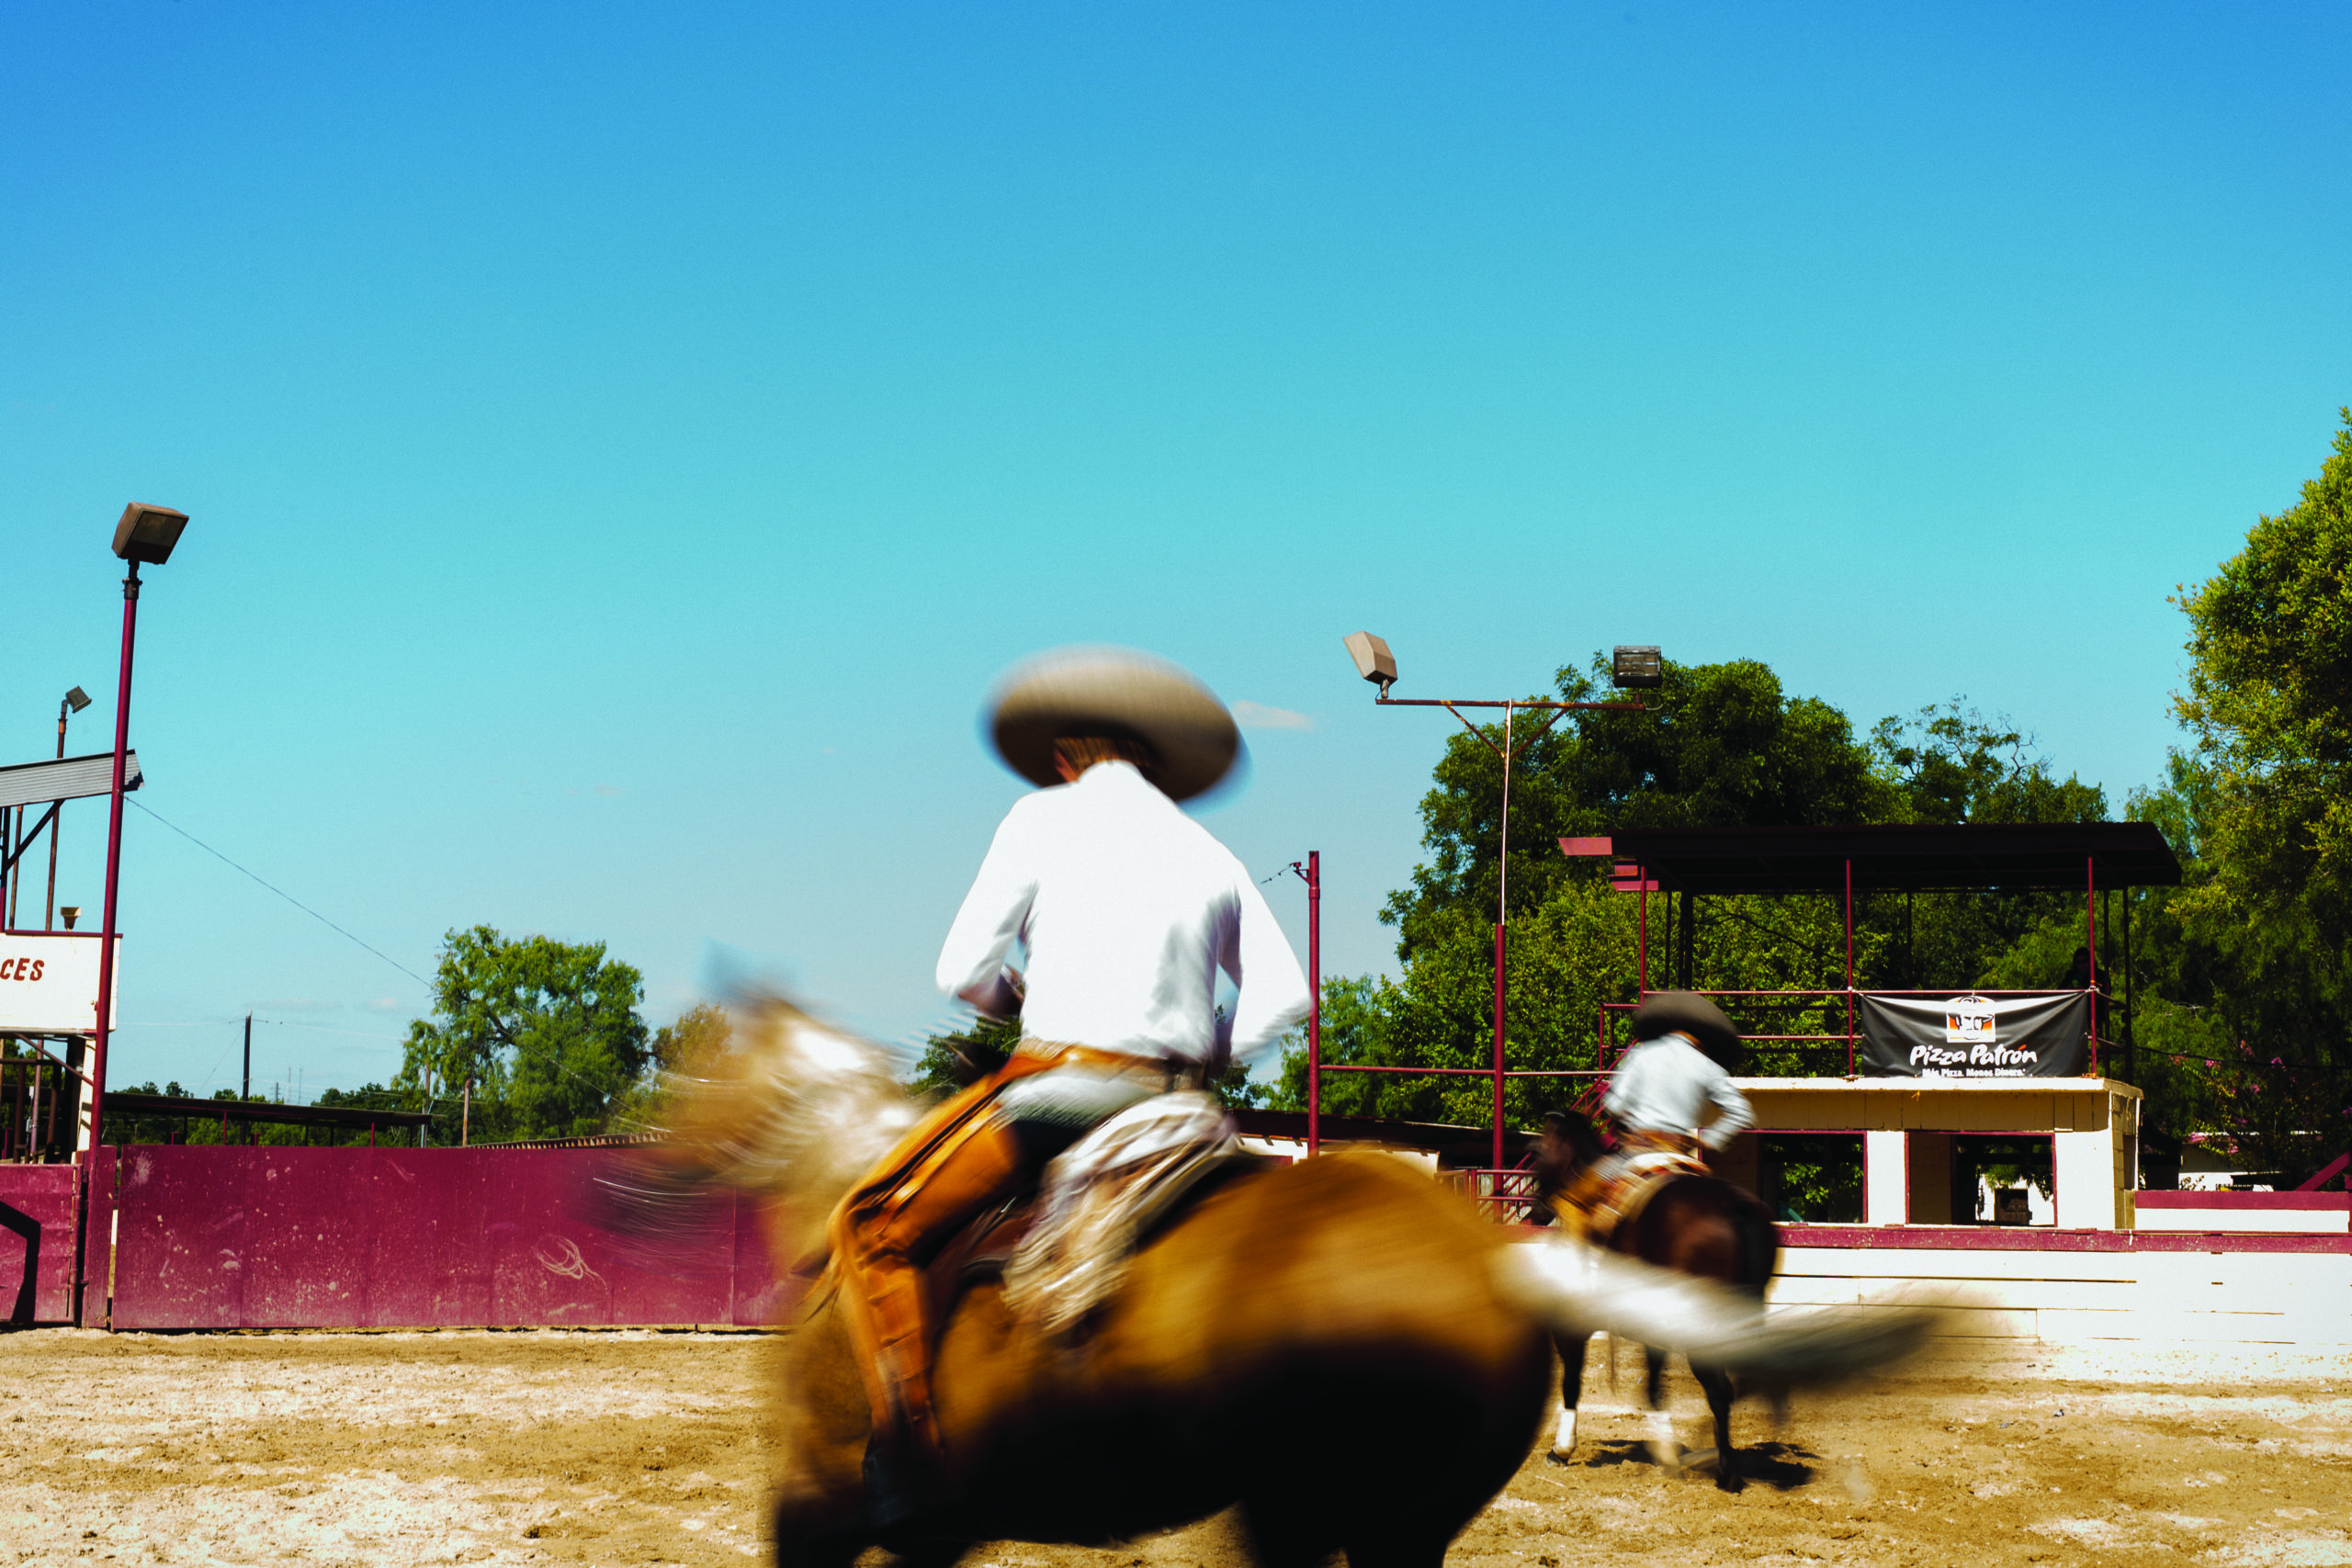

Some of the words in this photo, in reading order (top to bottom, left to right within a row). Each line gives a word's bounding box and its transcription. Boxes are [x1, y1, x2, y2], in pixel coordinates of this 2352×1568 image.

[0, 957, 45, 982] CES
[1909, 1044, 1967, 1066] Pizza
[1969, 1043, 2038, 1066] Patrón
